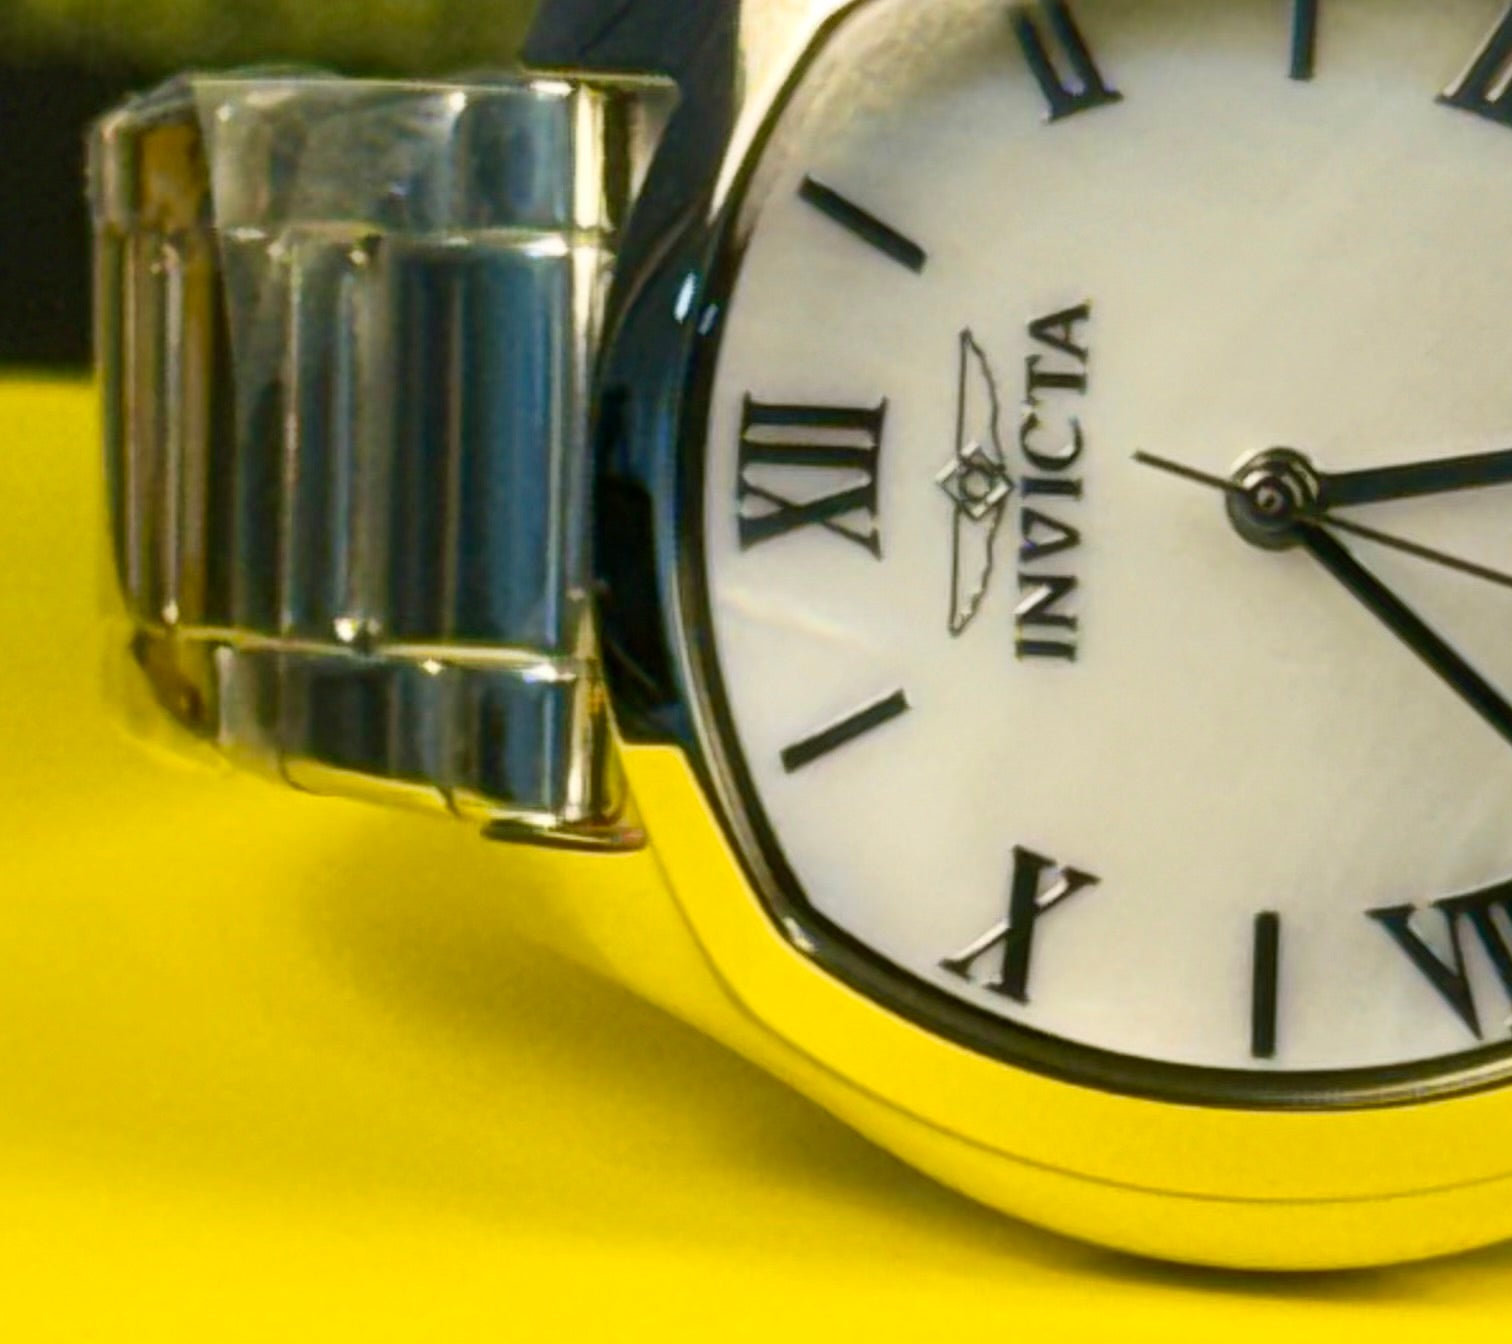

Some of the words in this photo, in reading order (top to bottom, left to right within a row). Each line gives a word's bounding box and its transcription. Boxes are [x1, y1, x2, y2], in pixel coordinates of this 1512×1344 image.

[736, 390, 886, 560] XII
[1014, 297, 1092, 662] INVICTA
[938, 844, 1100, 1004] X
